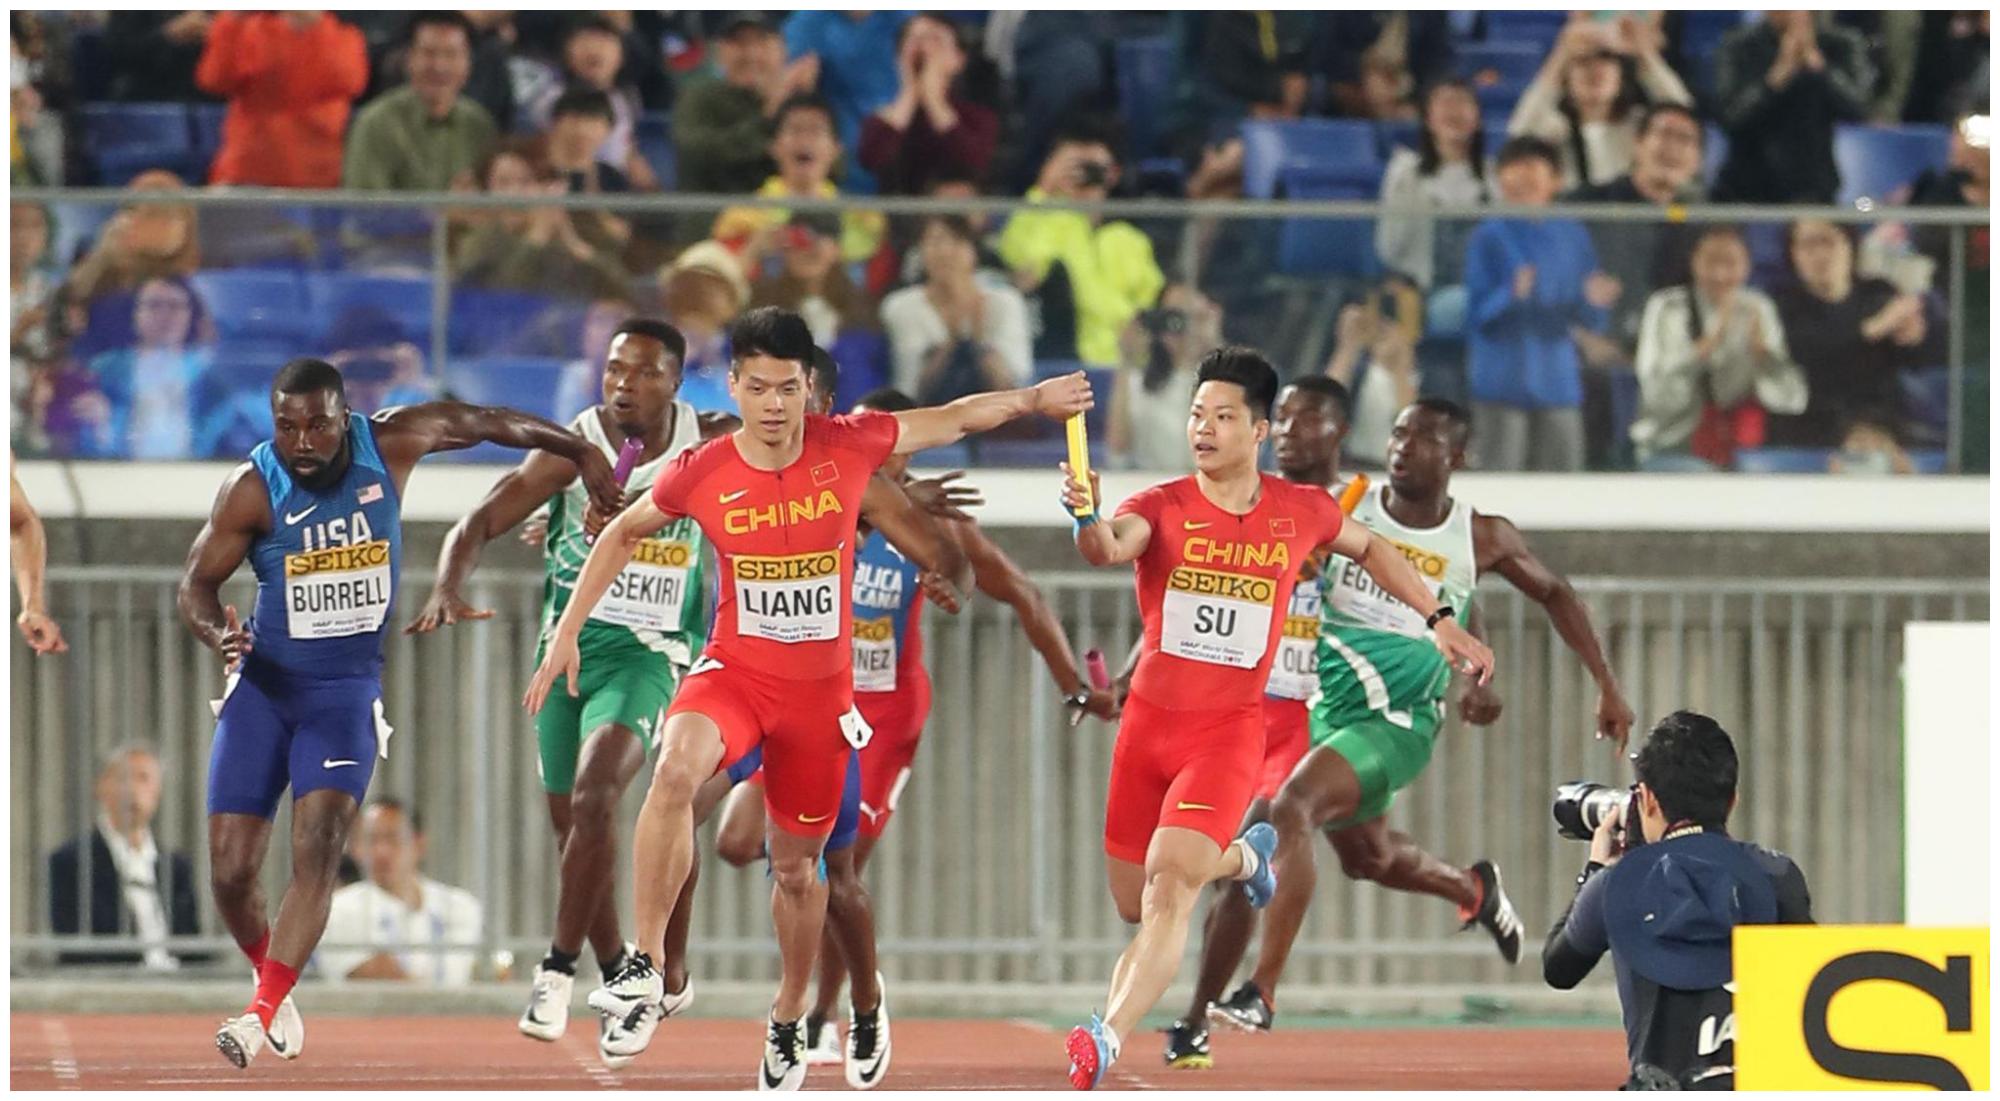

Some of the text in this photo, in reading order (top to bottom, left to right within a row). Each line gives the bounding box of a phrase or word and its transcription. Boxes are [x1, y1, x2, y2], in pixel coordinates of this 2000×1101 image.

[723, 489, 843, 535] CHINA
[302, 510, 373, 553] USA
[290, 544, 387, 575] SEIKO
[737, 554, 837, 580] SEIKO
[1182, 536, 1290, 571] CHINA
[292, 576, 387, 613] BURRELL
[743, 585, 833, 618] LIANG
[1171, 568, 1271, 602] SEIKO
[1193, 604, 1237, 637] SU
